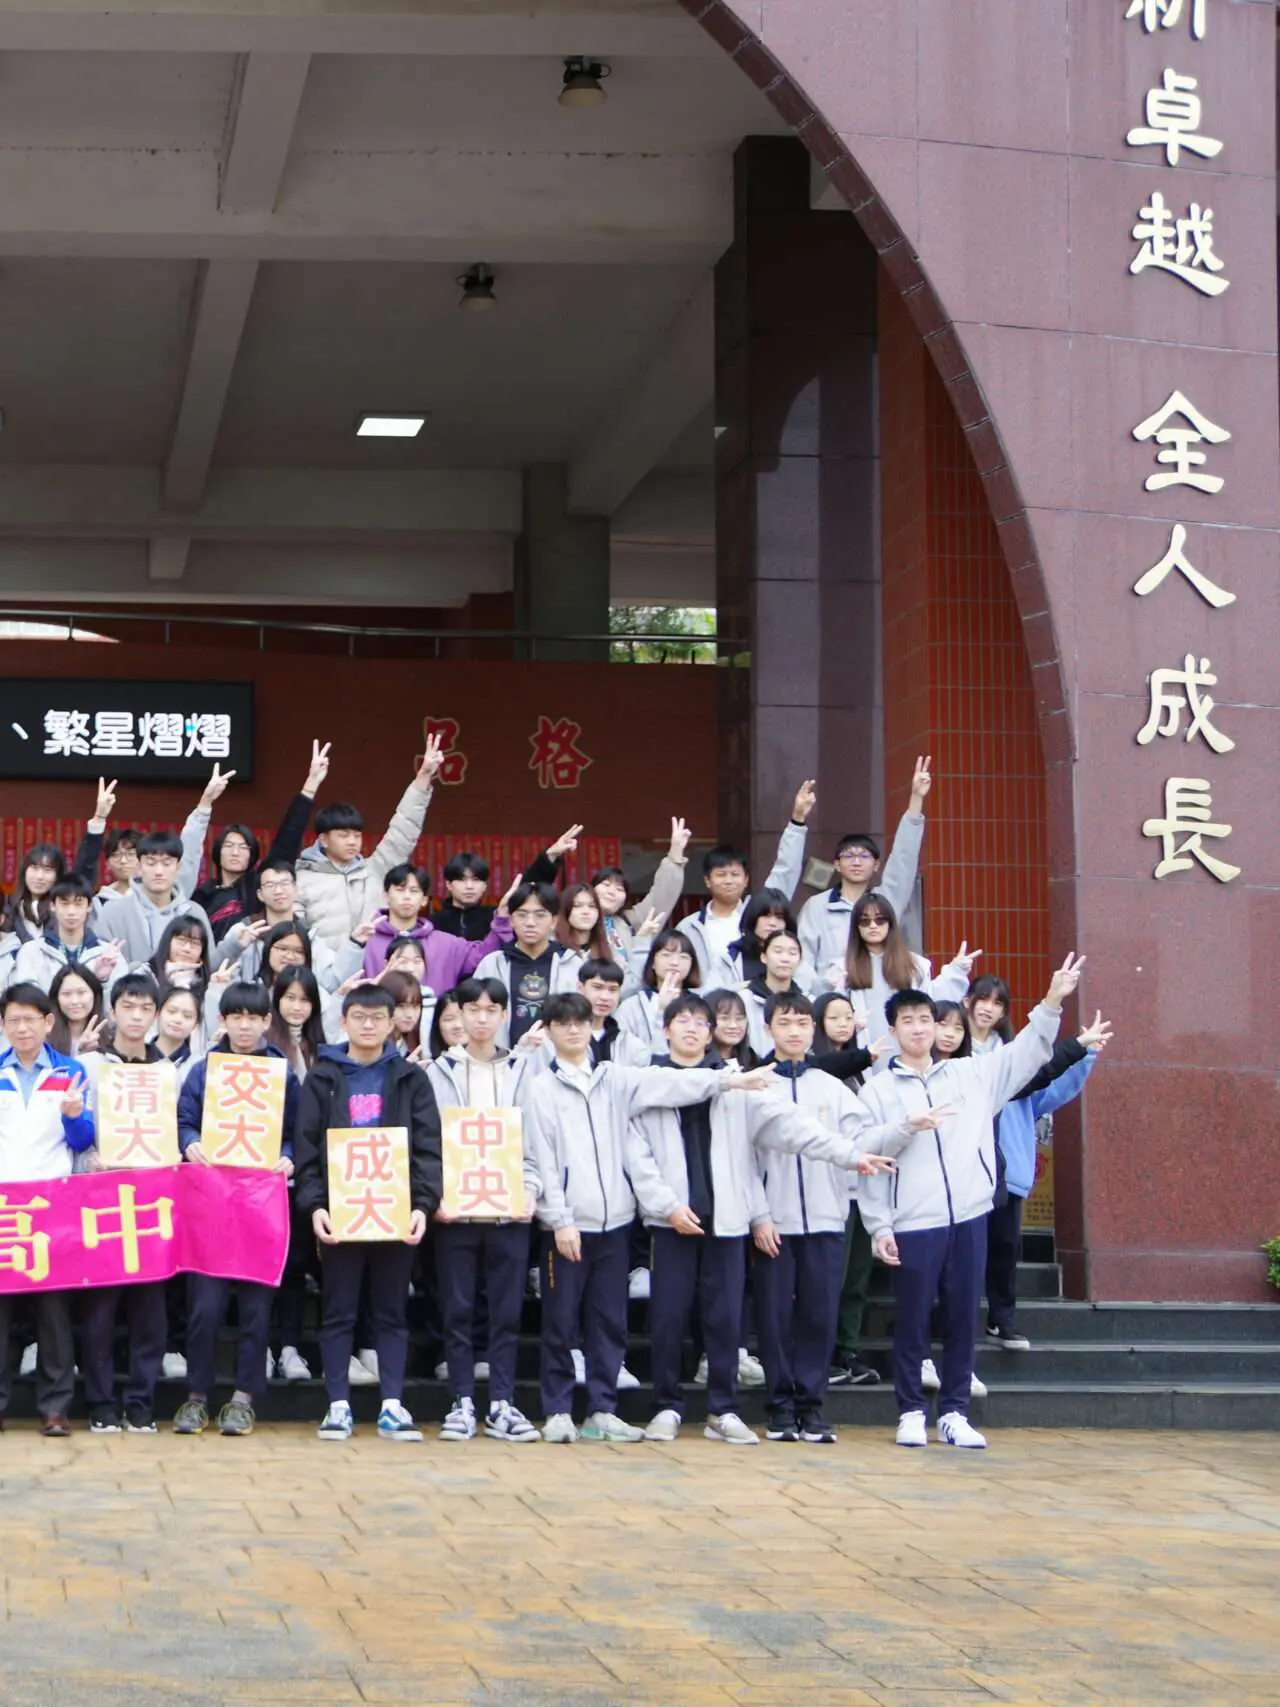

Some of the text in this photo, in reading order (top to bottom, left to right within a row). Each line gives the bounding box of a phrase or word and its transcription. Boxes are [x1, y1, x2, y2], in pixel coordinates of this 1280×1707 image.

[1133, 390, 1241, 882] 全人成長
[113, 1069, 164, 1163] 清大
[215, 1060, 269, 1163] 交大
[345, 1134, 394, 1234] 成大
[460, 1112, 510, 1212] 中央
